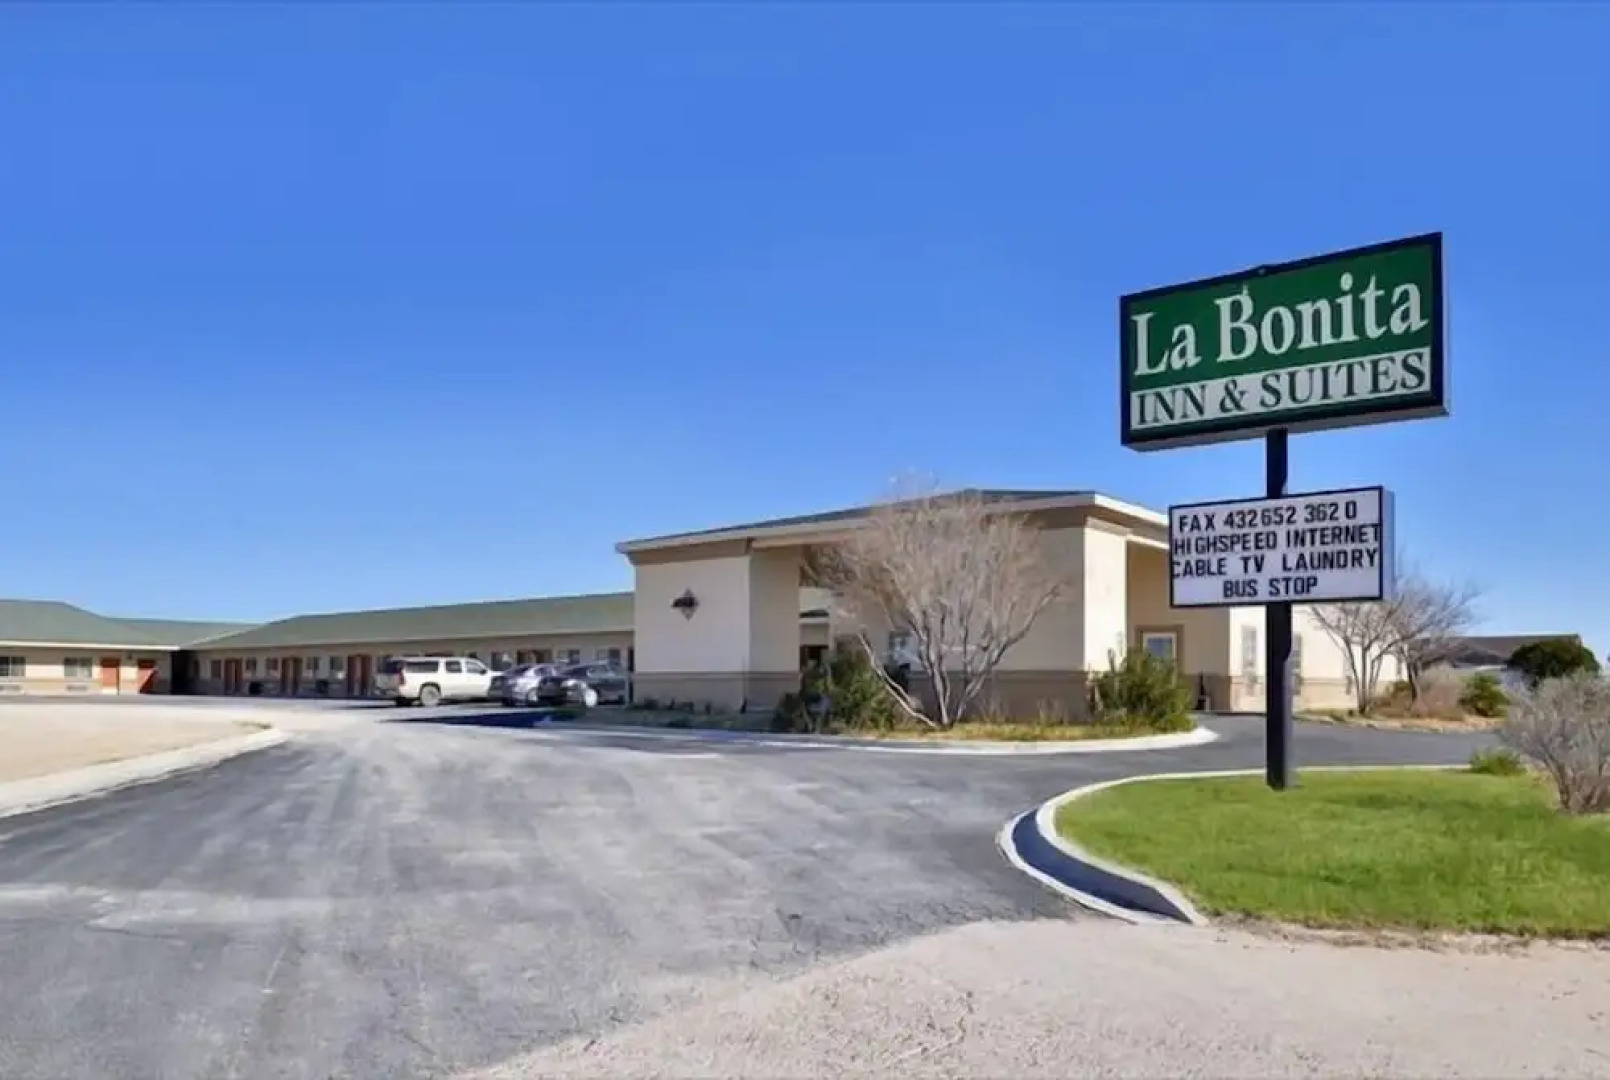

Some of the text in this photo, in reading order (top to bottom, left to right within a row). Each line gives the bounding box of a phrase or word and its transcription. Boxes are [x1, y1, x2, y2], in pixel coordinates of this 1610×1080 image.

[1131, 271, 1430, 376] La Bonita
[1137, 352, 1425, 425] INN & SUITES
[1174, 523, 1380, 555] HIGHSPEED INTERNET
[1179, 514, 1215, 533] FAX
[1172, 548, 1378, 578] CABLE TV LAUNDRY
[1223, 576, 1318, 598] BUS STOP
